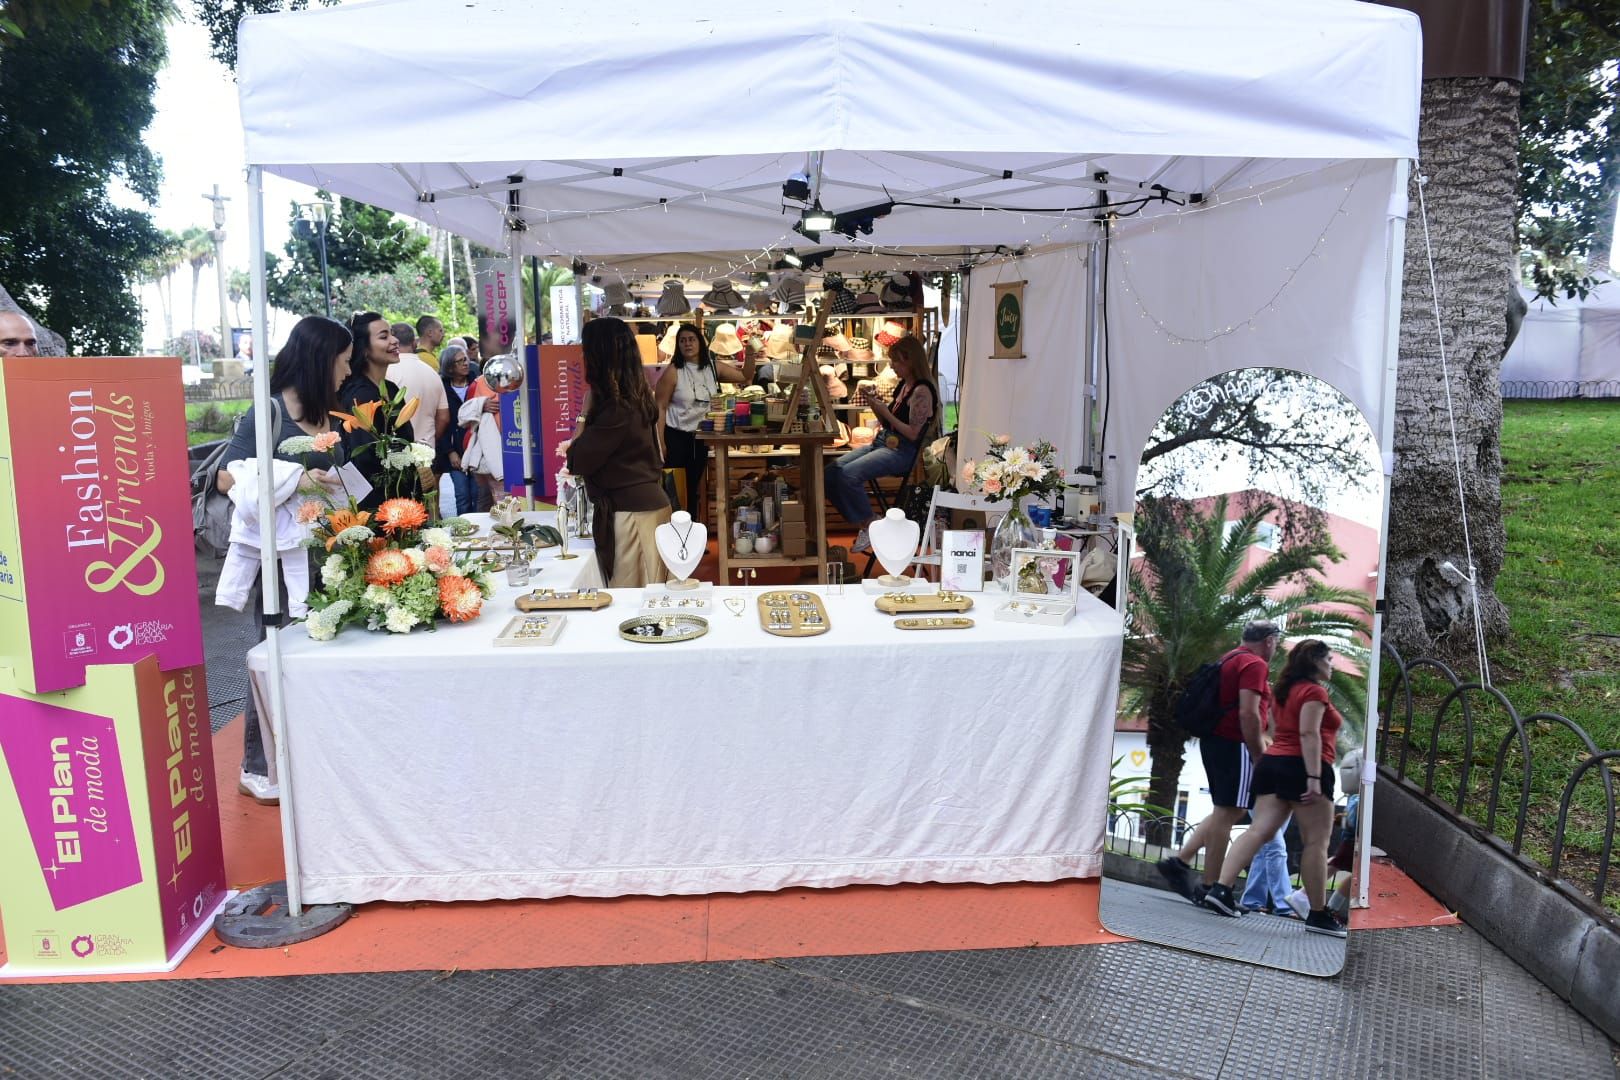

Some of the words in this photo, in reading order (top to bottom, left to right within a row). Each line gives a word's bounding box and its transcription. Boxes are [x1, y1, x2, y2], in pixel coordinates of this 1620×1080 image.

[497, 271, 509, 345] CONCEPT
[141, 400, 154, 440] Amigos
[554, 360, 570, 432] Fashion
[58, 388, 106, 553] Fashion
[95, 392, 144, 534] Friends
[143, 451, 156, 481] Moda
[85, 516, 165, 596] &
[951, 548, 976, 557] nanai
[163, 679, 187, 808] Plan
[180, 669, 201, 758] moda
[49, 737, 77, 824] Plan
[76, 736, 105, 801] moda
[190, 767, 205, 802] de
[55, 831, 82, 864] El
[84, 807, 108, 833] de
[173, 811, 193, 866] El
